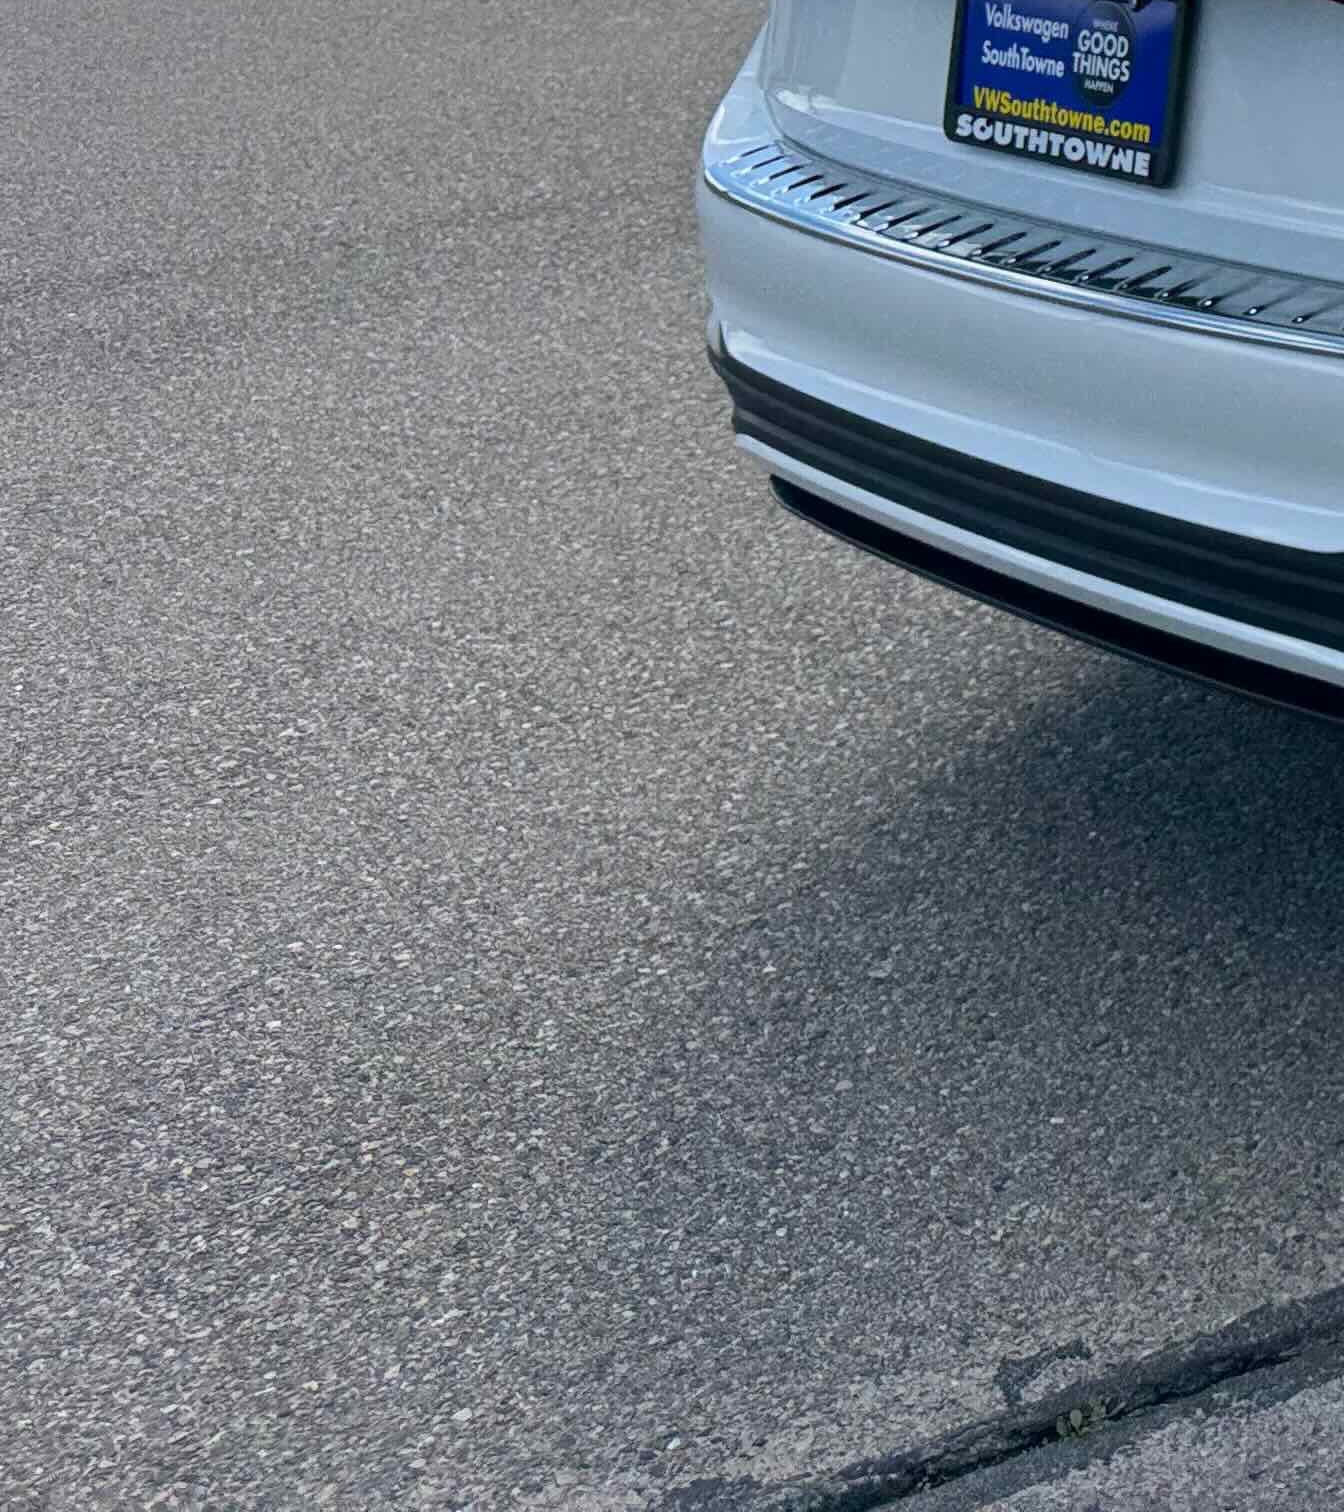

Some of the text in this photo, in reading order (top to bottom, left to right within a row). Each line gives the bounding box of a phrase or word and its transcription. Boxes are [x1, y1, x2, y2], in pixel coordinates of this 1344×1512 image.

[984, 1, 1069, 43] Volkswagen
[981, 39, 1065, 78] SouthTowne
[1077, 29, 1129, 58] GOOD
[1072, 51, 1131, 82] THINGS
[973, 85, 1150, 143] VWSouthtowne.com
[955, 112, 1151, 177] SOUTHTOWNE
